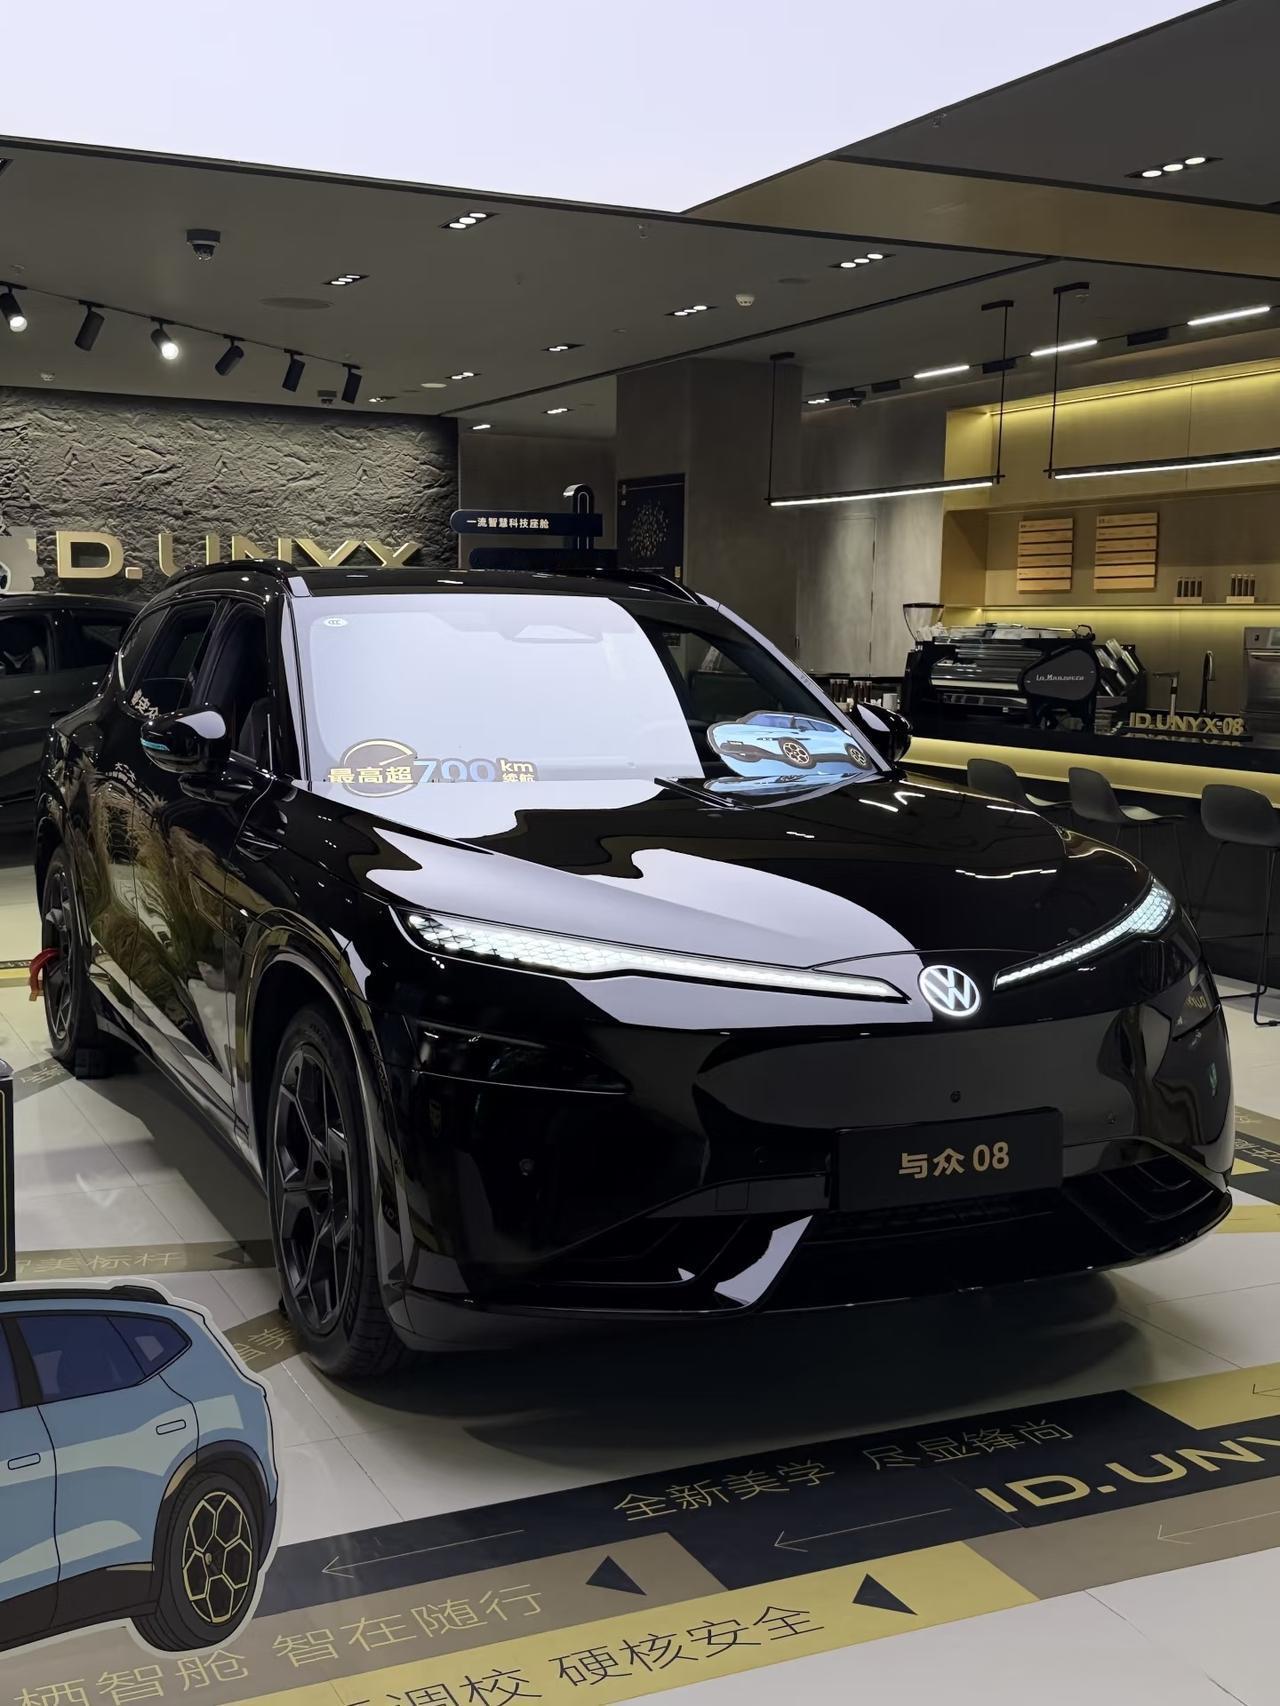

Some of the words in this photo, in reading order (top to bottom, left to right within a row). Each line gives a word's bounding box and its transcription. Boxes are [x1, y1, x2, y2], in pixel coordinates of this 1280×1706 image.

[466, 516, 549, 529] 一流智慧科技座舱
[1129, 711, 1245, 736] ID.UNYX-08
[328, 767, 414, 784] 最高超
[413, 759, 496, 784] 700
[500, 760, 533, 773] km
[898, 1147, 965, 1179] 与众
[972, 1141, 1010, 1172] 08
[613, 1458, 834, 1522] 全新美学
[862, 1419, 1073, 1470] 尽显锋尚
[271, 1583, 542, 1668] 智在随行
[547, 1605, 825, 1686] 硬核安全
